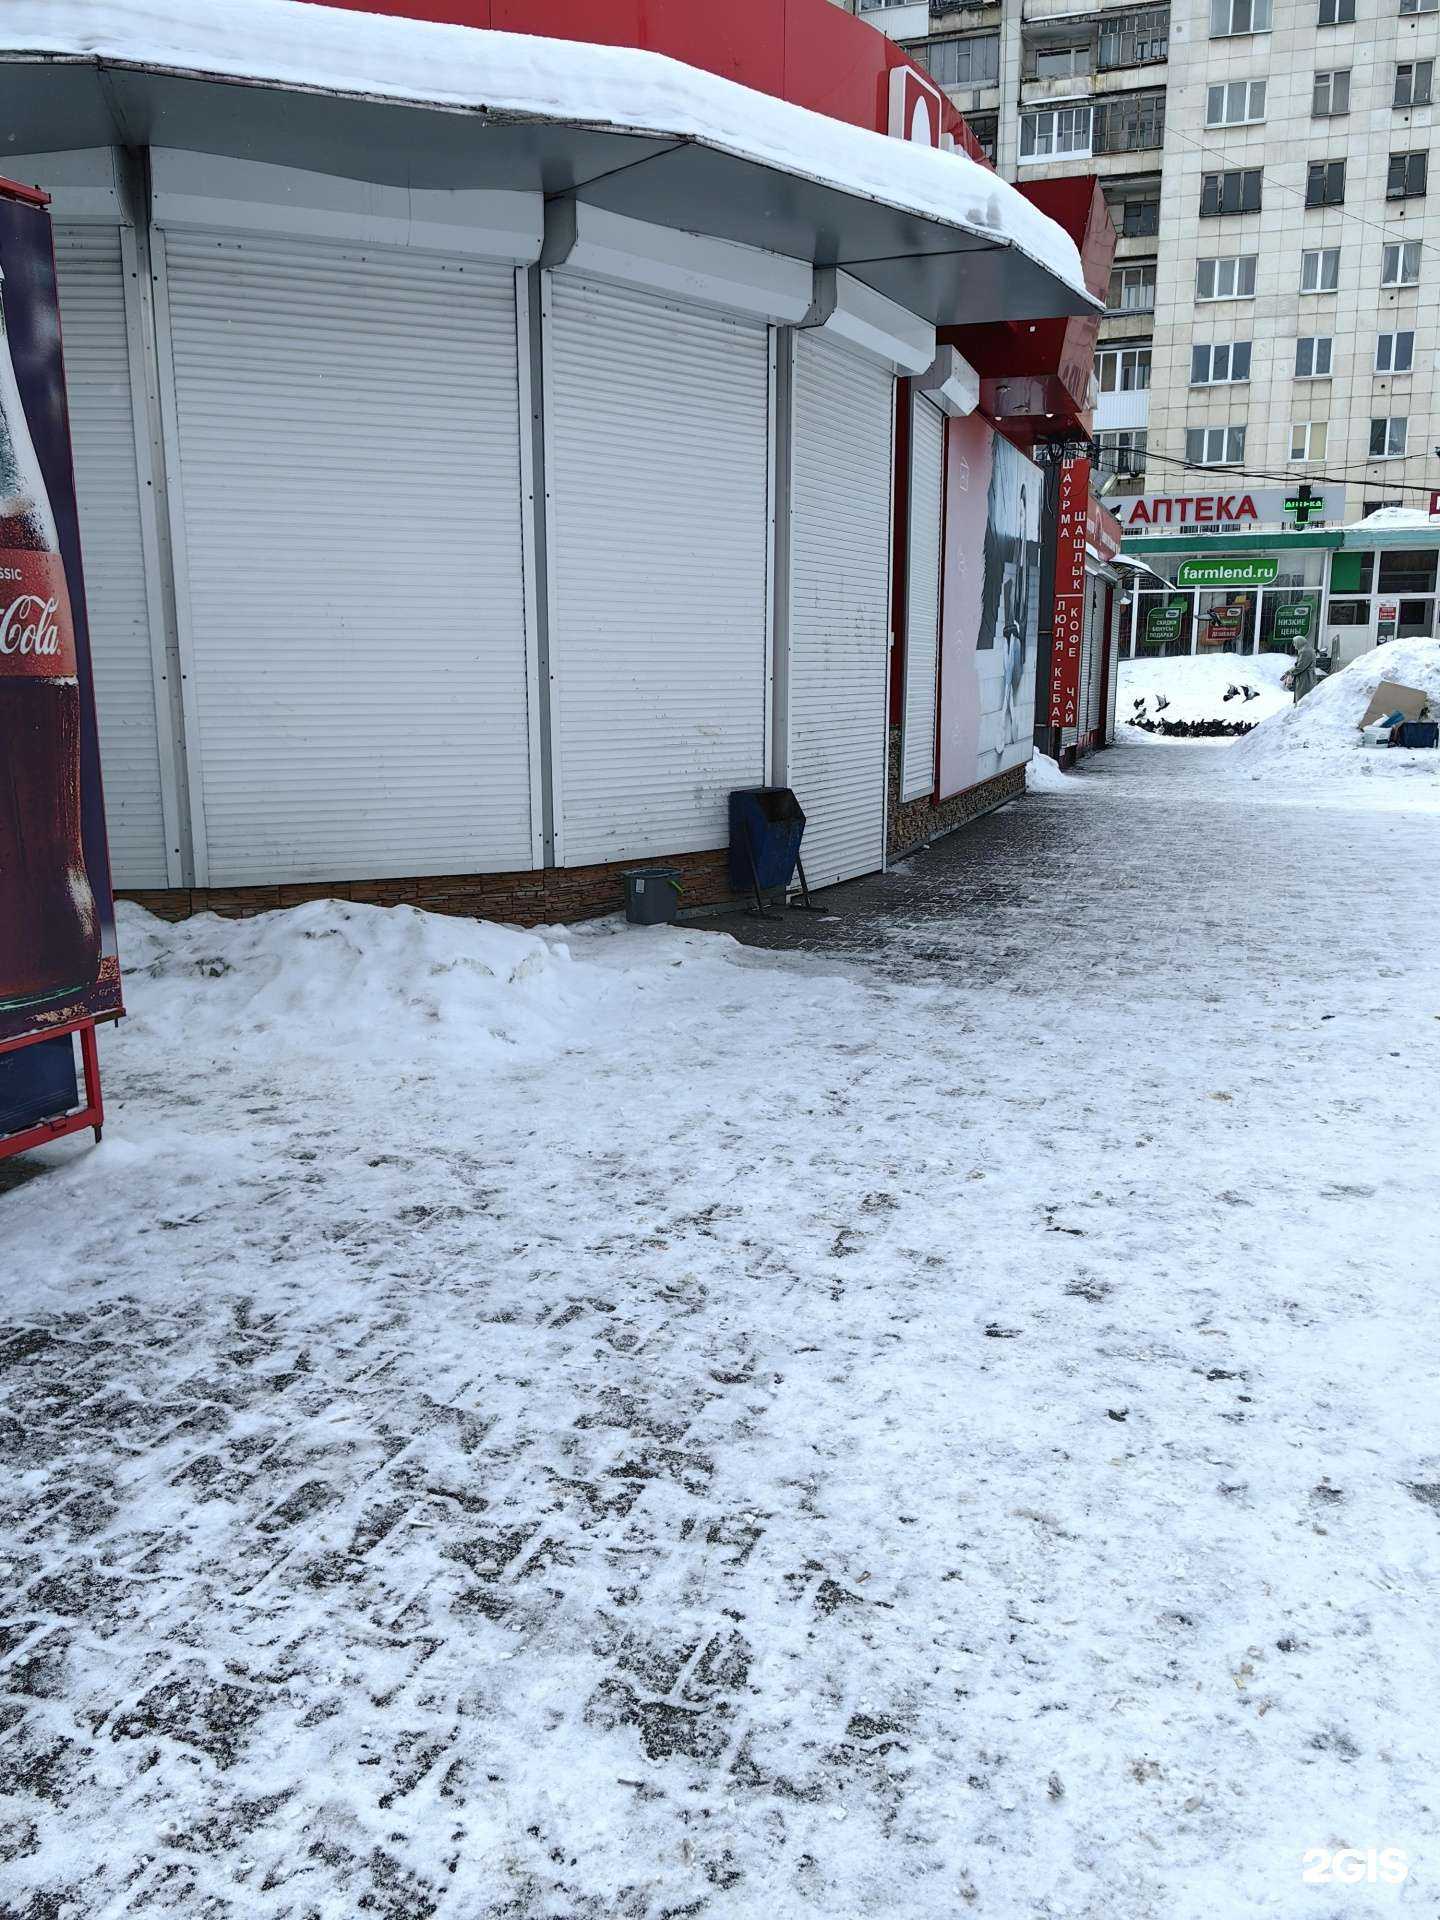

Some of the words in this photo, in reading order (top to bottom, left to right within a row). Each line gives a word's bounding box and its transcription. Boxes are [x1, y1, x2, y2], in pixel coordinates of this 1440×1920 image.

[1060, 459, 1074, 538] ШАУРМА
[1128, 495, 1258, 524] АПТЕКА
[1071, 511, 1086, 590] ШАШЛЫК
[1183, 565, 1274, 579] farmlend.ru
[1068, 607, 1079, 657] КОФЕ
[1278, 618, 1306, 626] НИЗКИЕ
[1281, 628, 1302, 636] ЦЕНЫ
[1065, 687, 1075, 723] ЧАЙ
